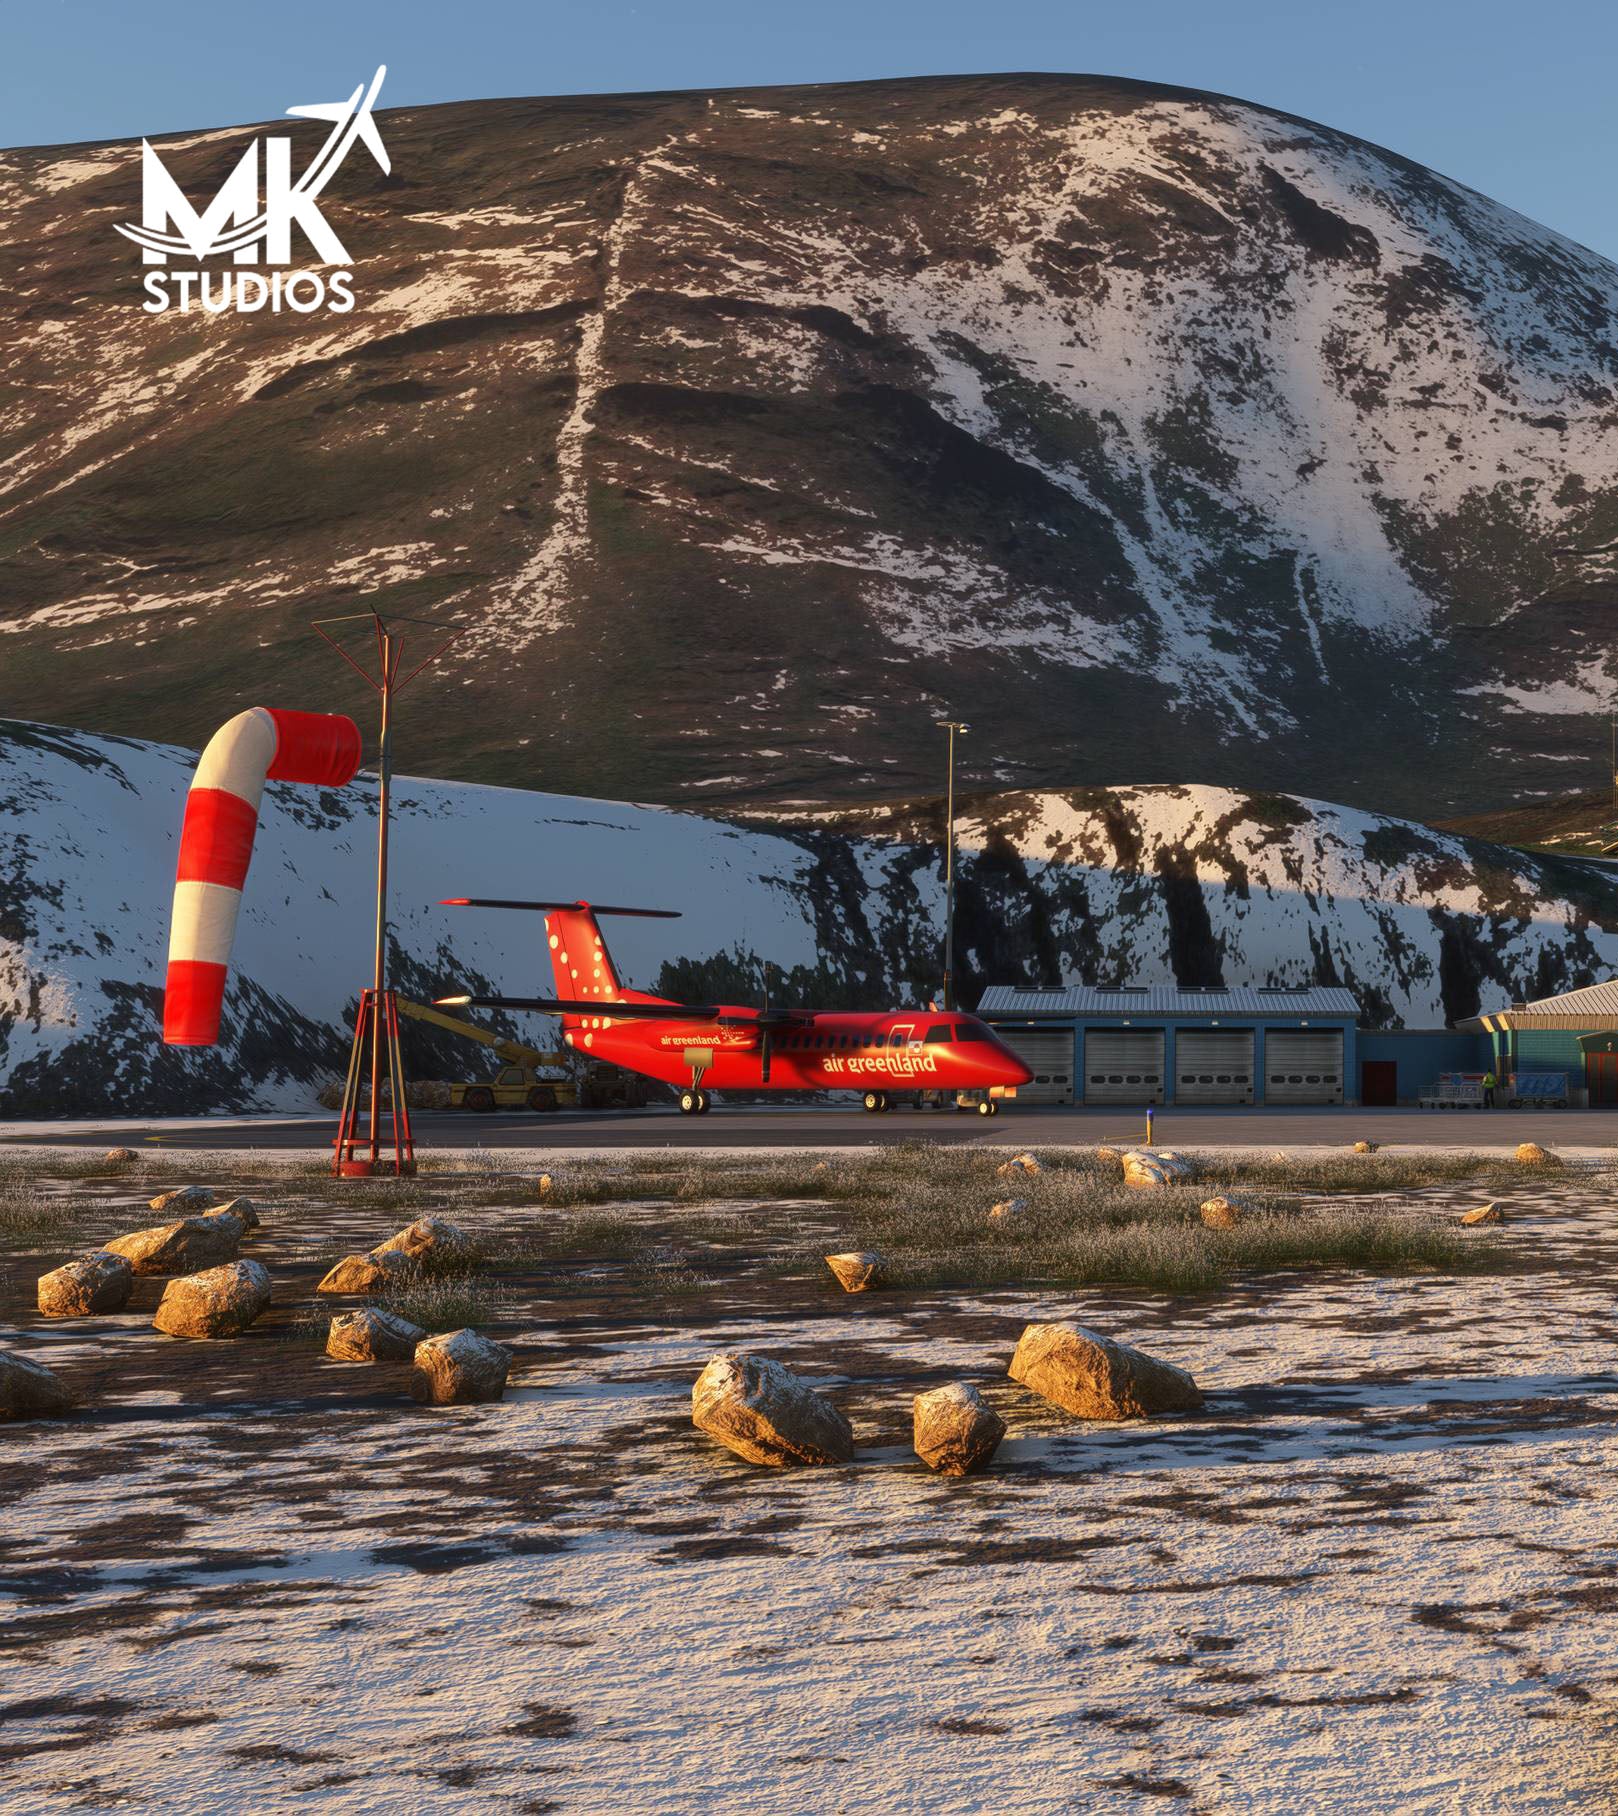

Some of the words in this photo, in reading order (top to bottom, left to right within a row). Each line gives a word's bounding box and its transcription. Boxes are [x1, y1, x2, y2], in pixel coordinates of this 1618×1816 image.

[661, 1035, 671, 1045] air
[672, 1035, 721, 1046] greenland
[823, 1053, 844, 1072] air
[847, 1053, 937, 1075] greenland
